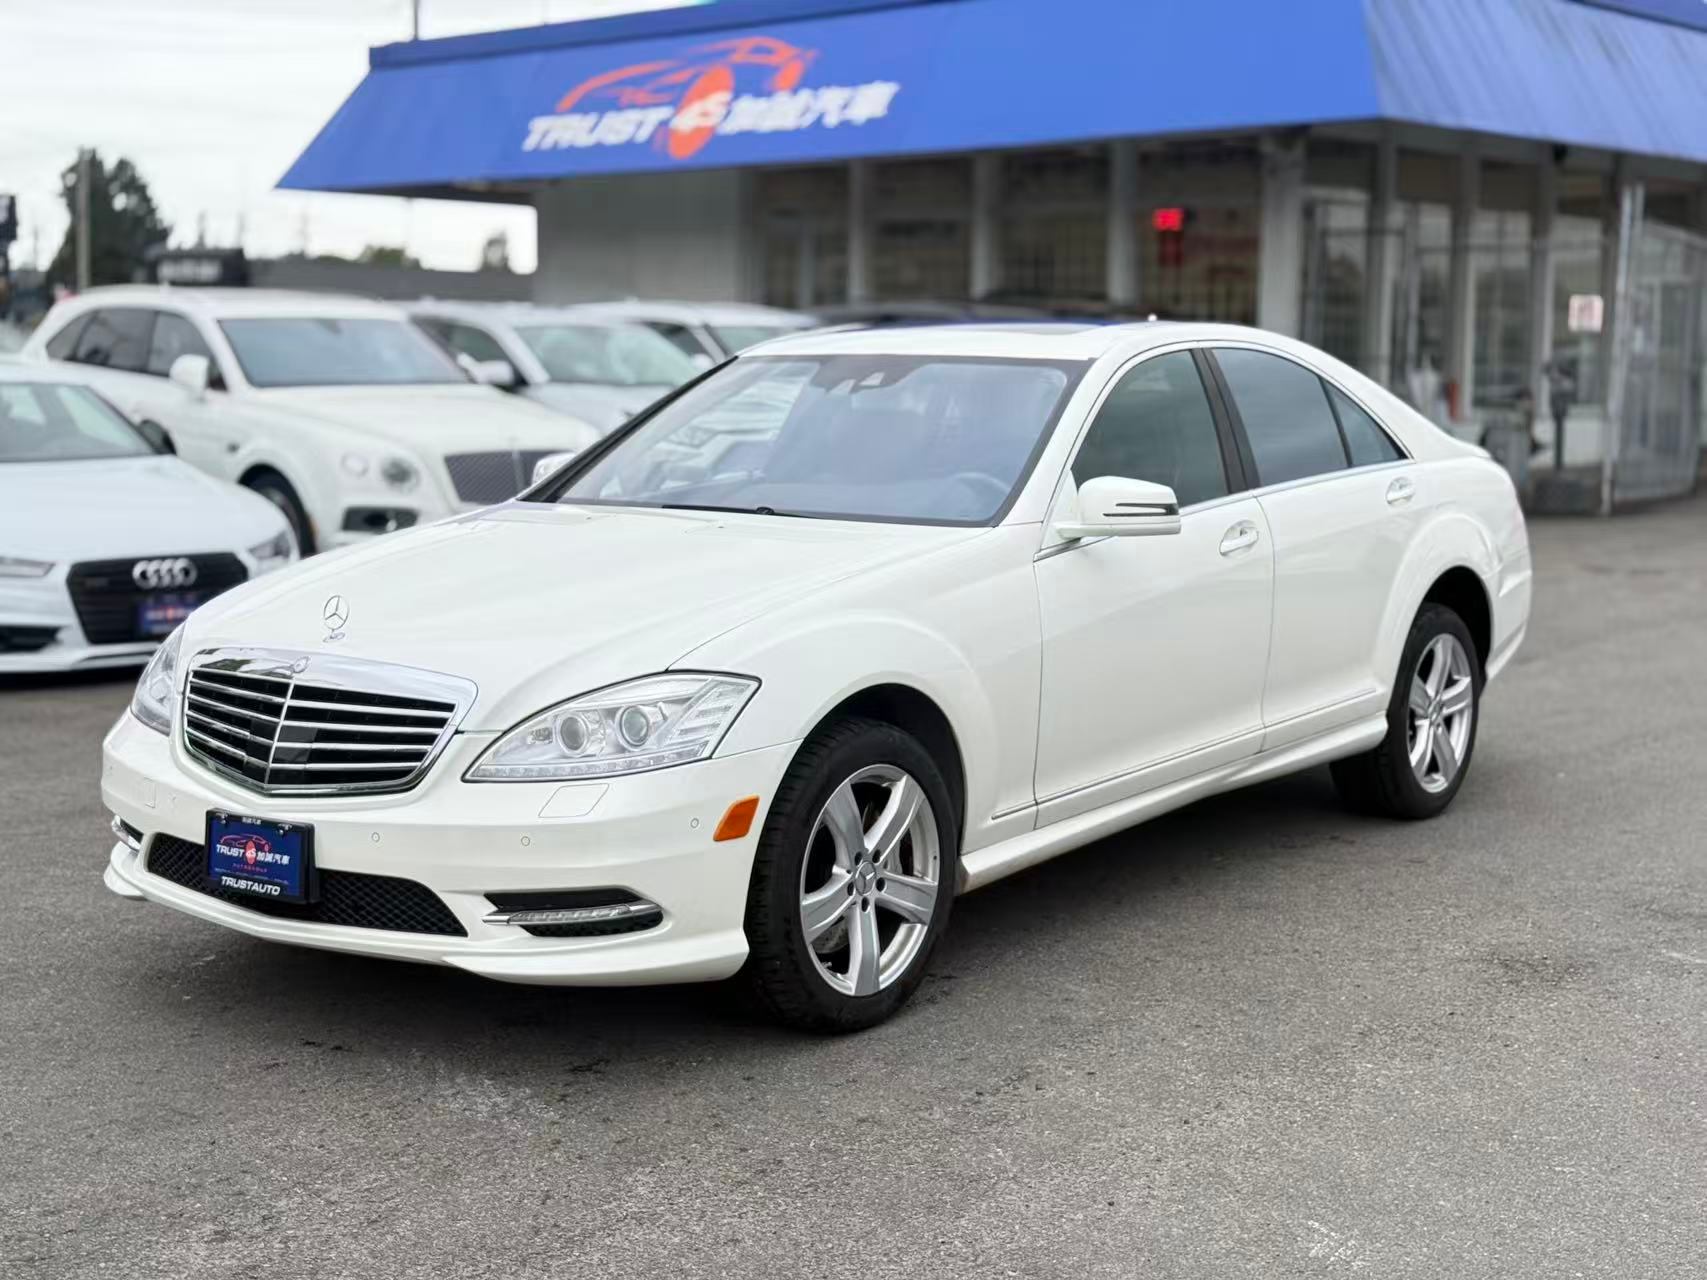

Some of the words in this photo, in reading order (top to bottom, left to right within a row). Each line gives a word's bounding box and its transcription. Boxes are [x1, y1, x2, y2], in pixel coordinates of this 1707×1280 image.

[522, 106, 674, 151] TRUST
[216, 844, 244, 857] TRUST
[221, 876, 281, 896] TRUSTAUTO
